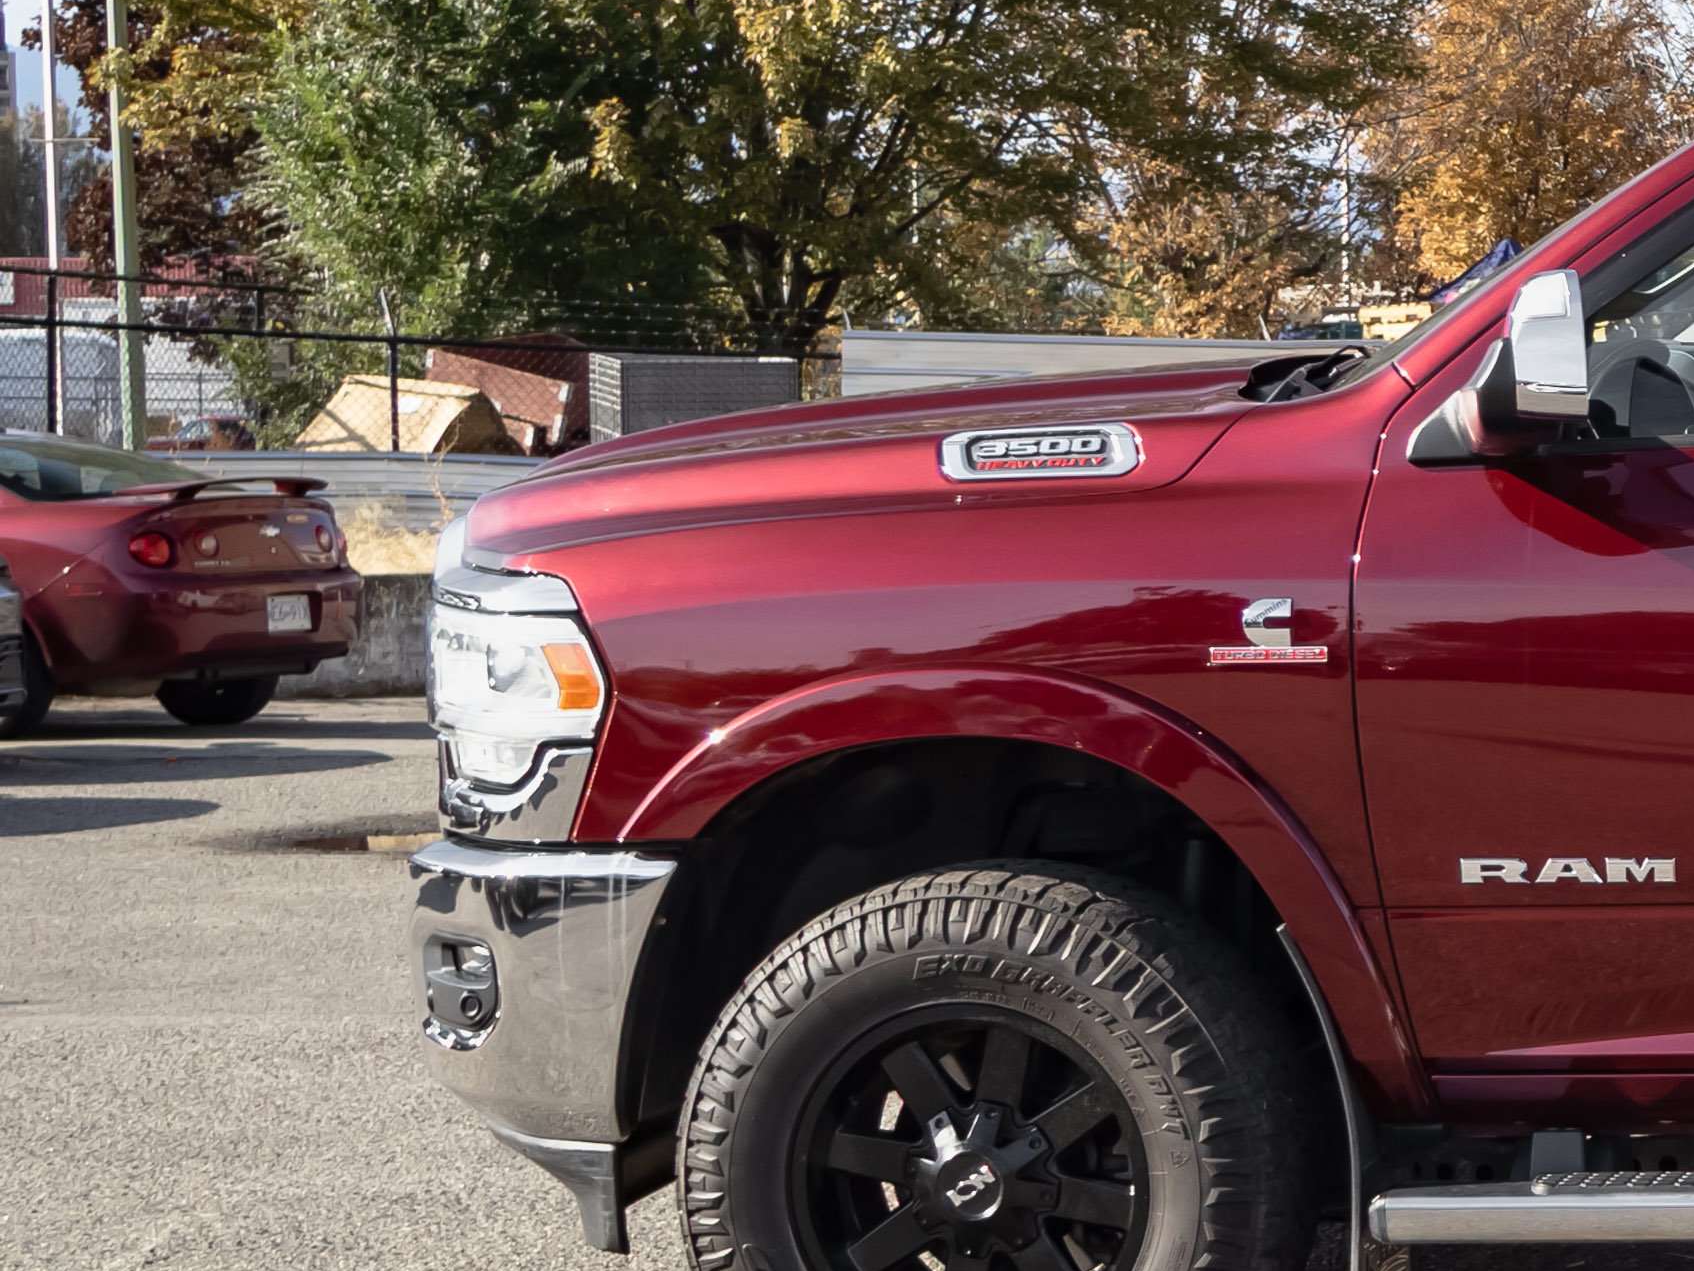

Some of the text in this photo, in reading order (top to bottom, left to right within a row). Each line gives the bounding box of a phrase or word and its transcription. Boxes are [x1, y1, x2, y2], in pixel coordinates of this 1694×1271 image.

[976, 436, 1102, 458] 3500
[975, 456, 1106, 471] HEAVY DUTY
[1459, 856, 1677, 885] RAM
[912, 953, 990, 981] EXO
[945, 1163, 996, 1208] ION
